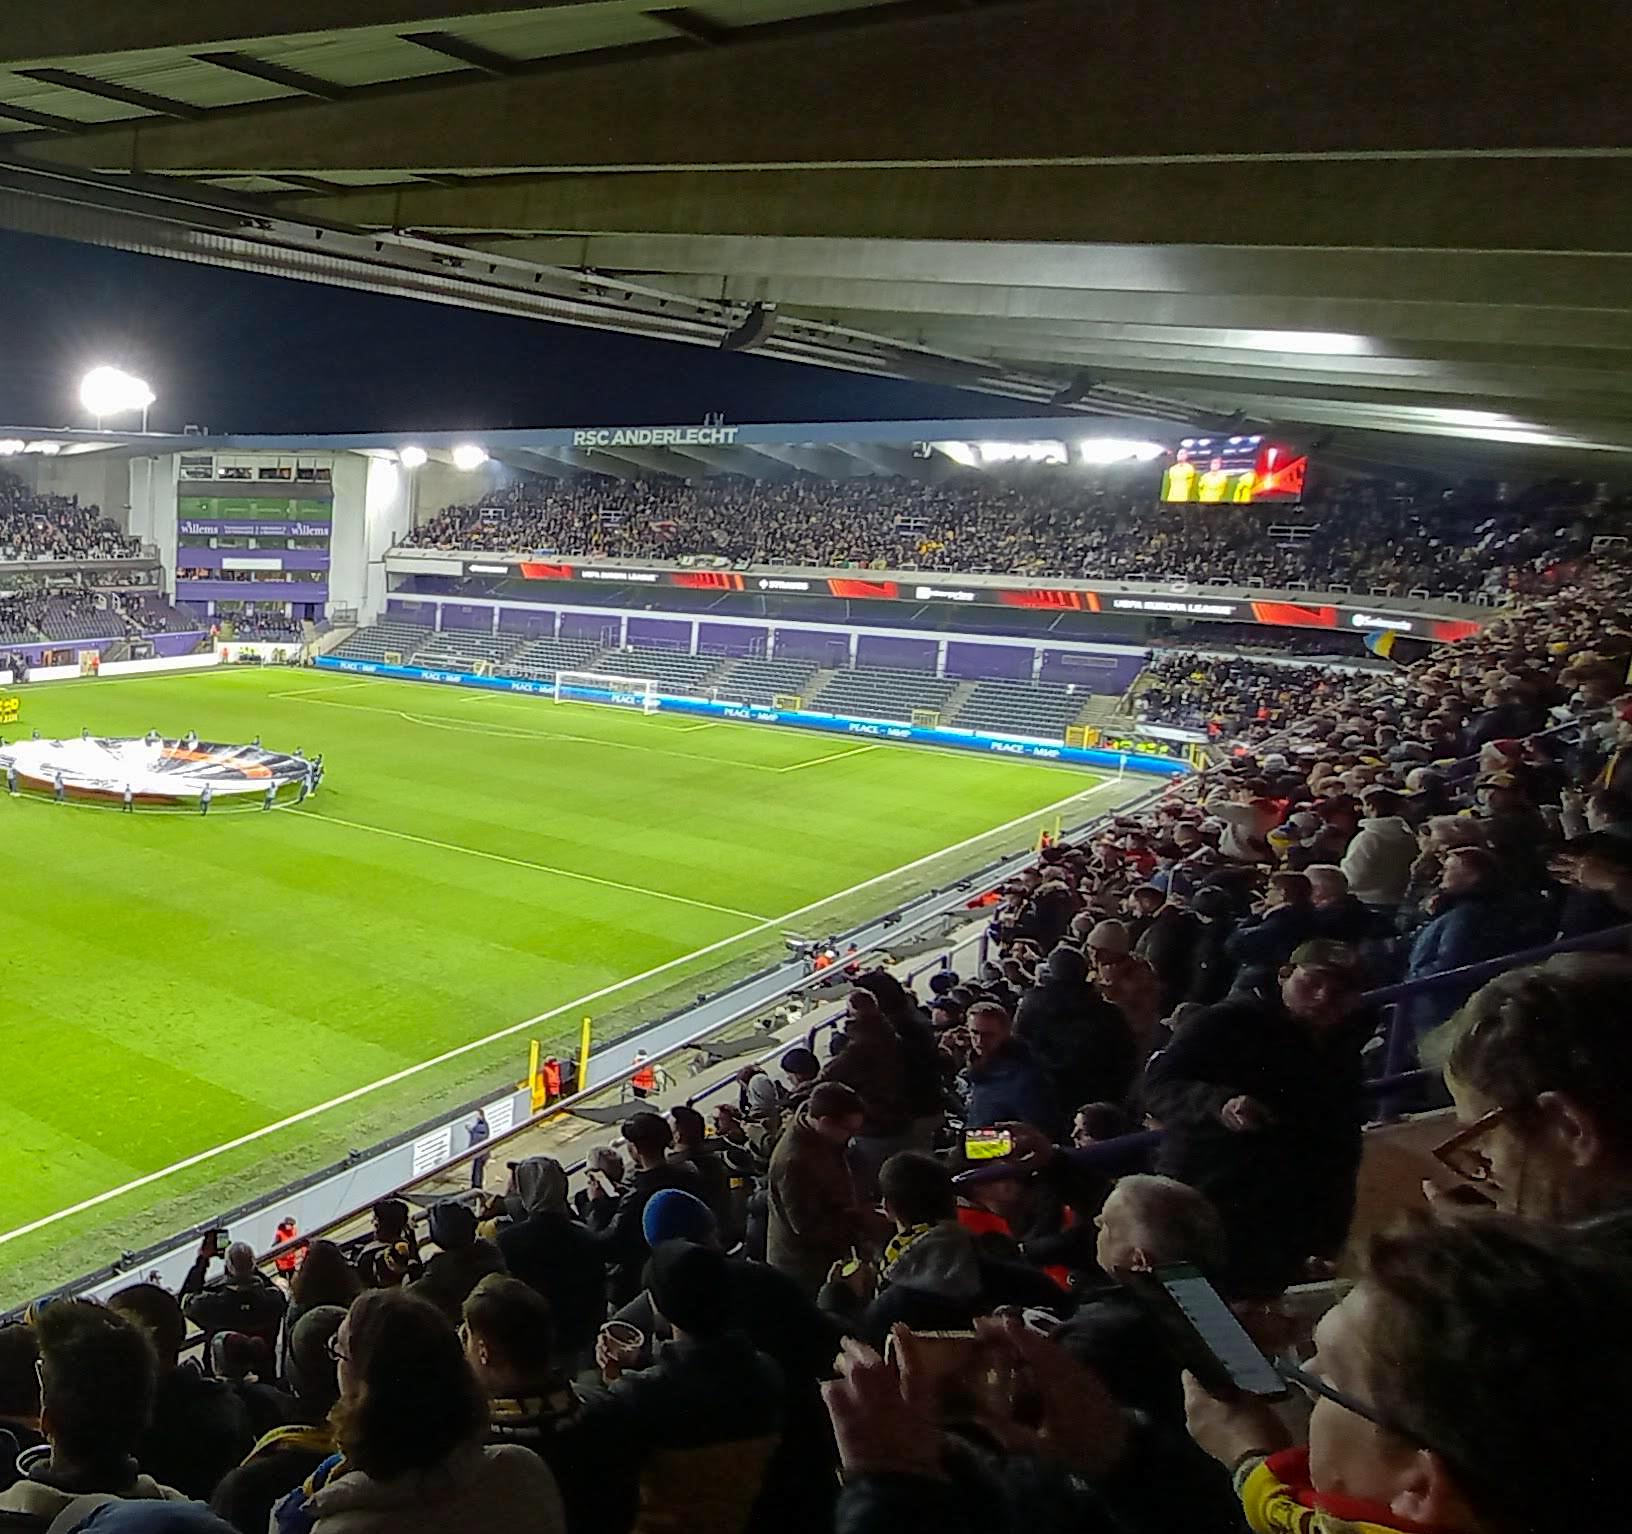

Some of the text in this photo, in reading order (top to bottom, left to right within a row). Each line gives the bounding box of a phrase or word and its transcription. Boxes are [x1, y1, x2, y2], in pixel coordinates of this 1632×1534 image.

[573, 428, 739, 446] RSC ANDERLECHT
[181, 521, 218, 534] willems
[291, 522, 329, 536] willems
